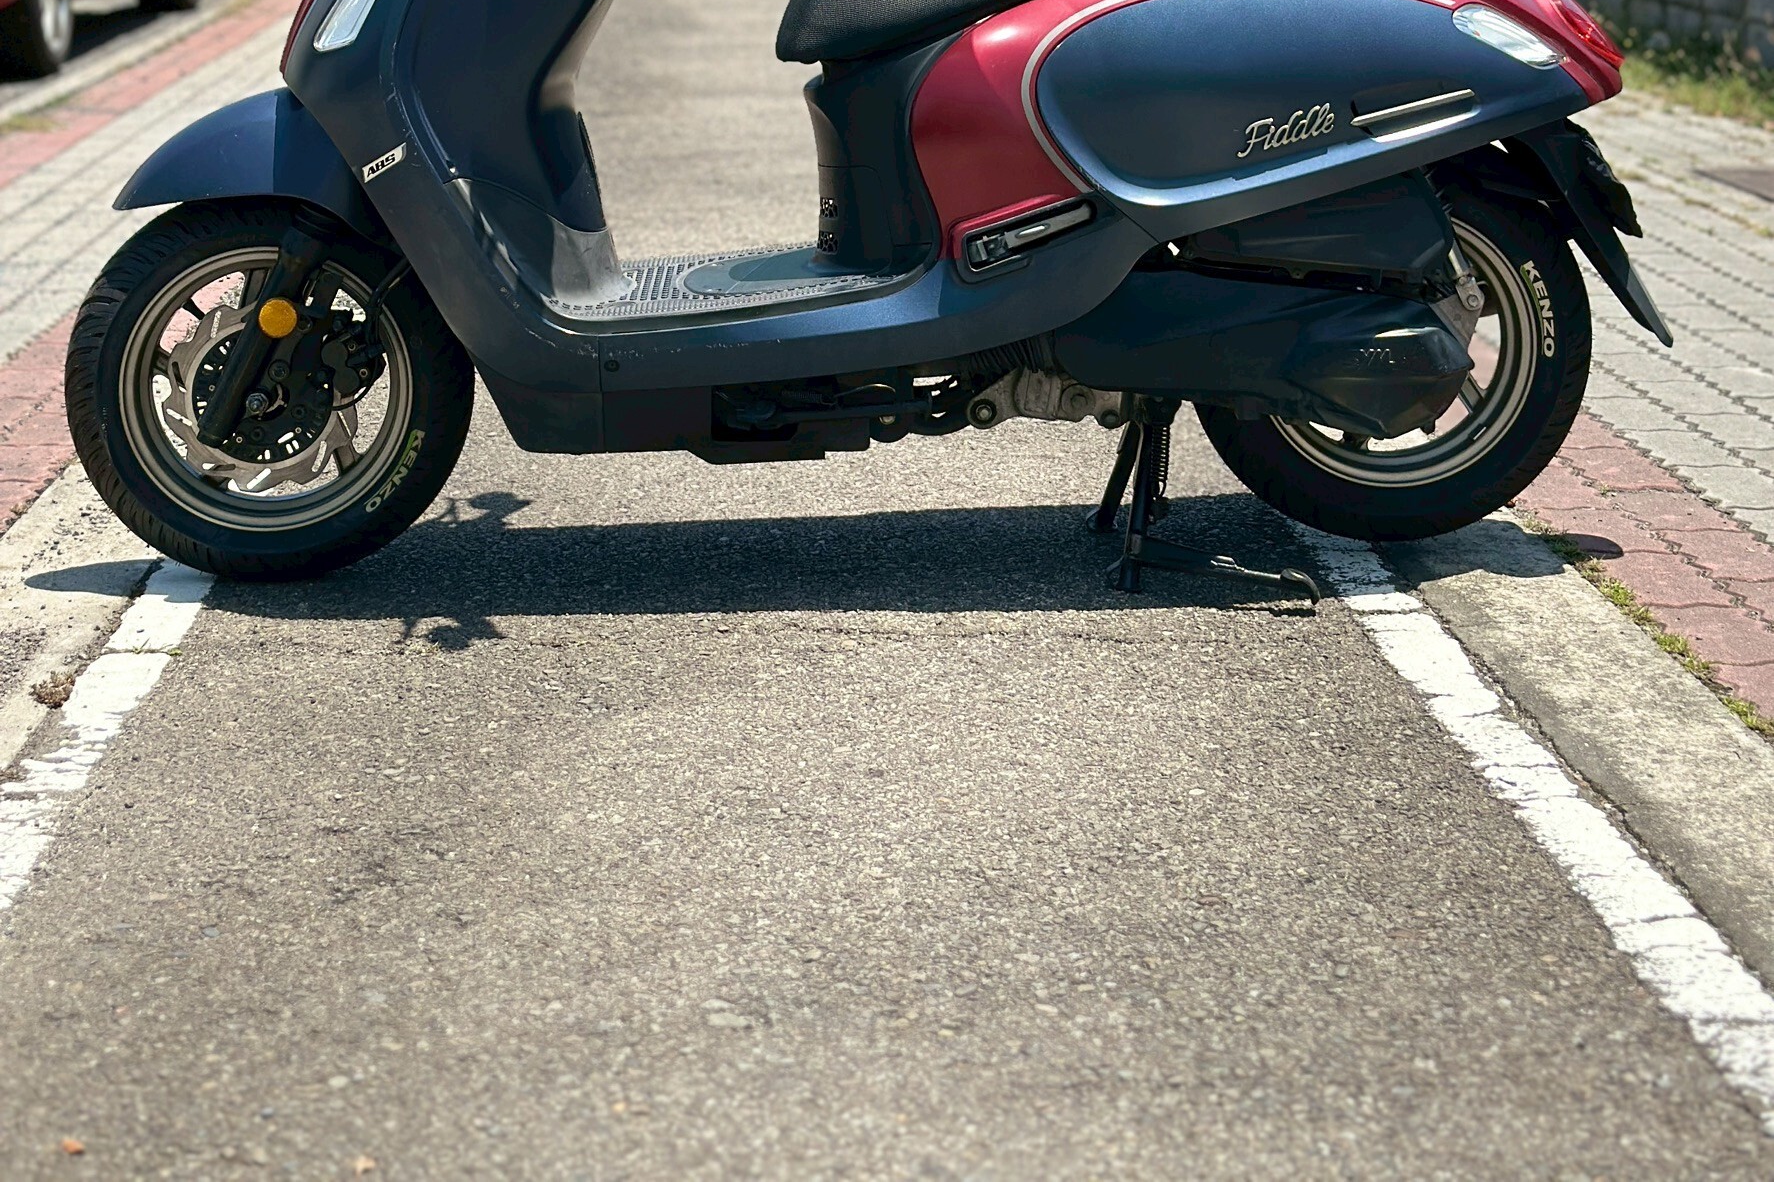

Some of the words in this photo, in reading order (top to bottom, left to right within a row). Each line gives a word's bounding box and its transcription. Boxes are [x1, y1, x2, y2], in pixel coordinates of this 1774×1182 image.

[1237, 102, 1335, 158] Fiddle
[366, 153, 396, 178] ABS
[1522, 260, 1555, 358] KENZO
[364, 429, 426, 513] KENZO
